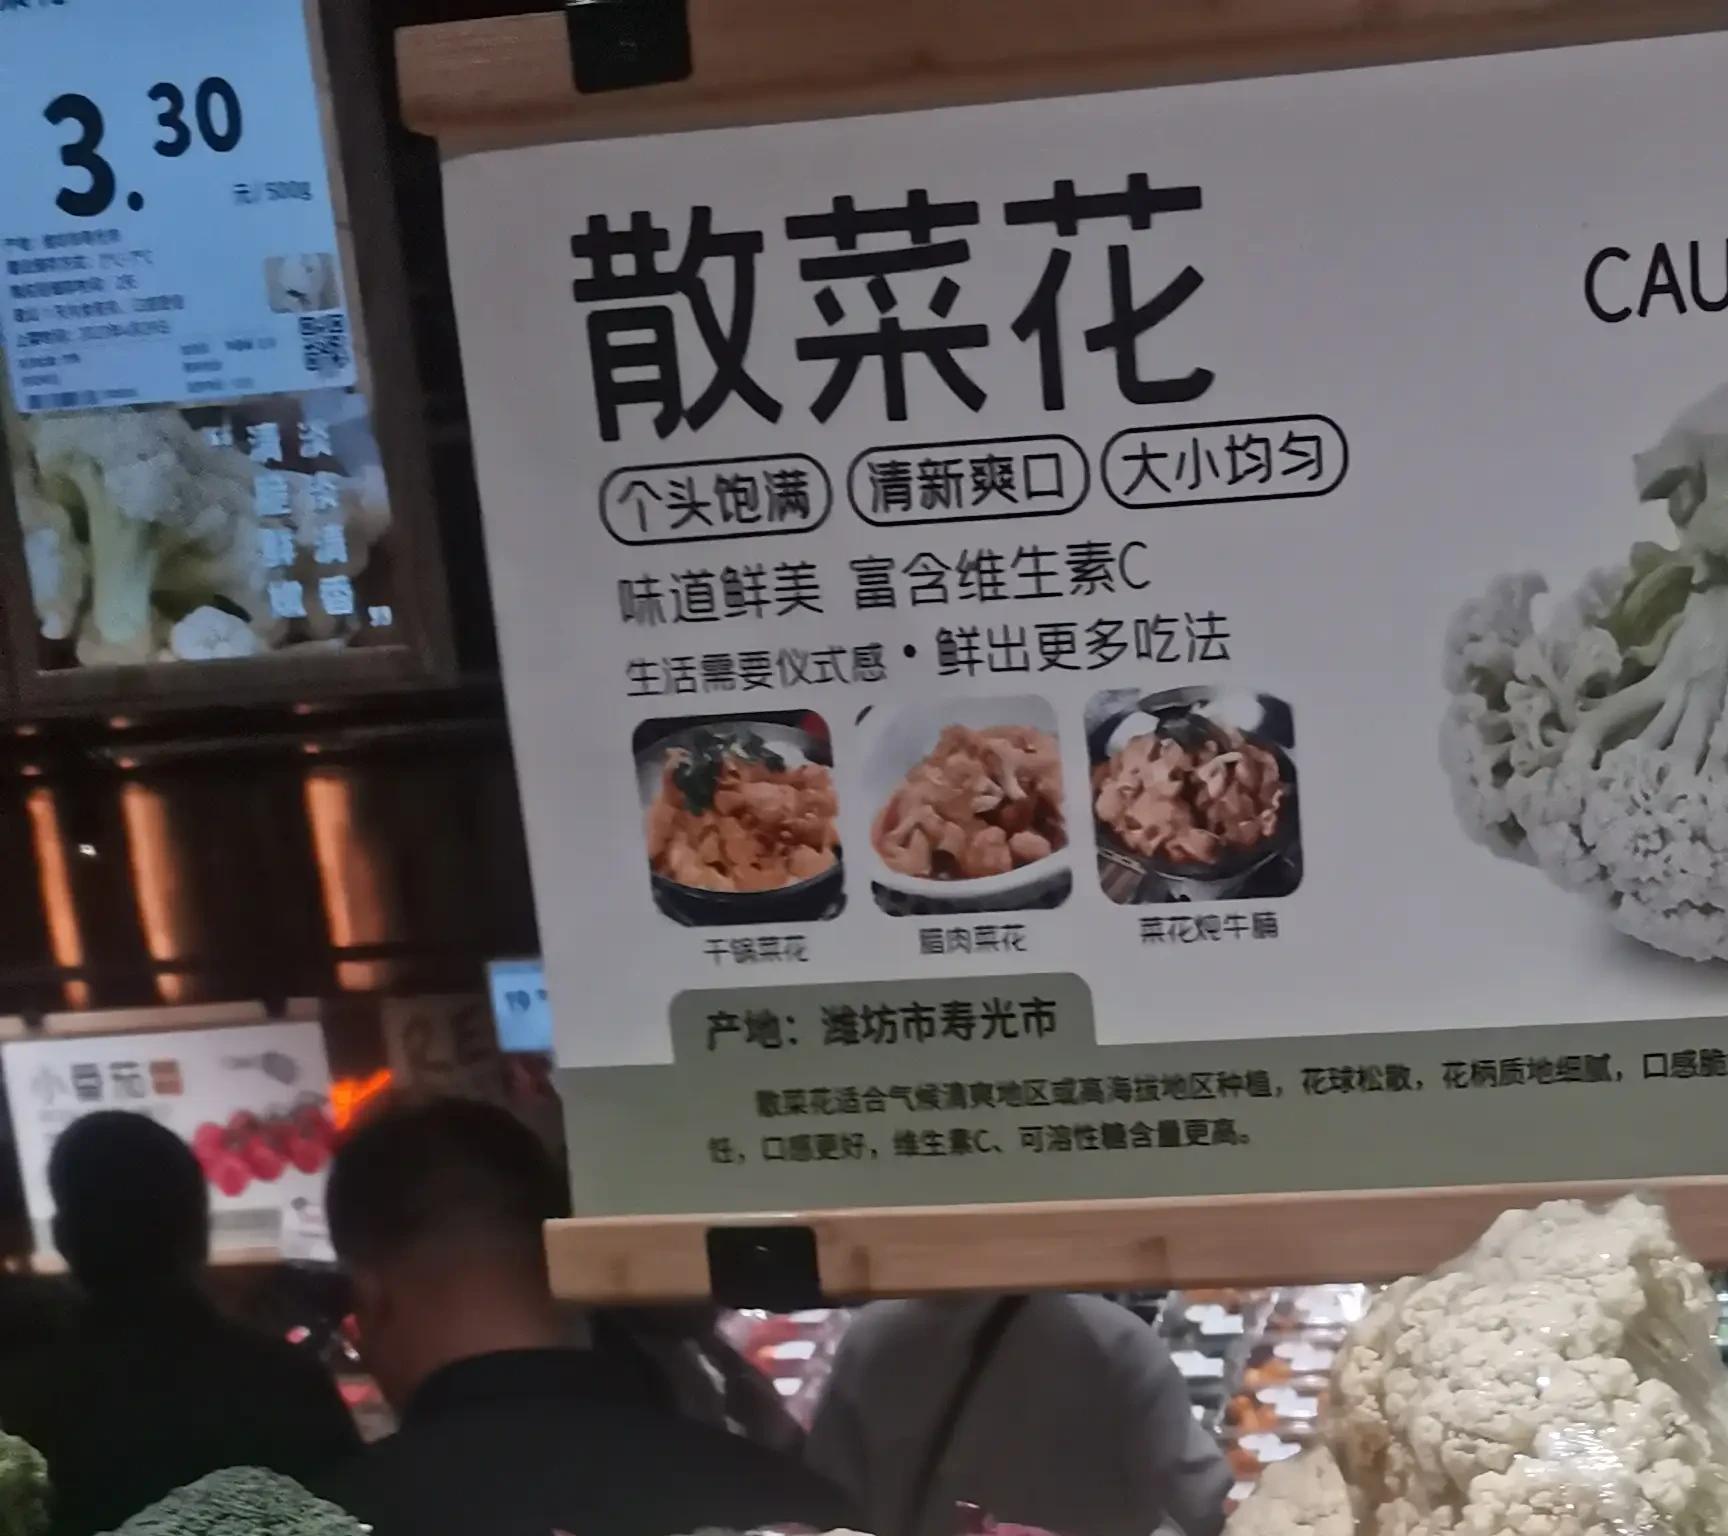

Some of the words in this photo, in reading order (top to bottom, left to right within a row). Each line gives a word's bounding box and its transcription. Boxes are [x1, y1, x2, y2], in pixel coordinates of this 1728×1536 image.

[570, 172, 1215, 443] 散菜花
[618, 464, 812, 532] 个头饱满
[868, 450, 1067, 515] 清新爽口
[1121, 431, 1325, 498] 大小均匀
[618, 561, 825, 628] 味道鲜美
[851, 540, 1152, 614] 富含维生素C
[703, 933, 809, 968] 干锅菜花
